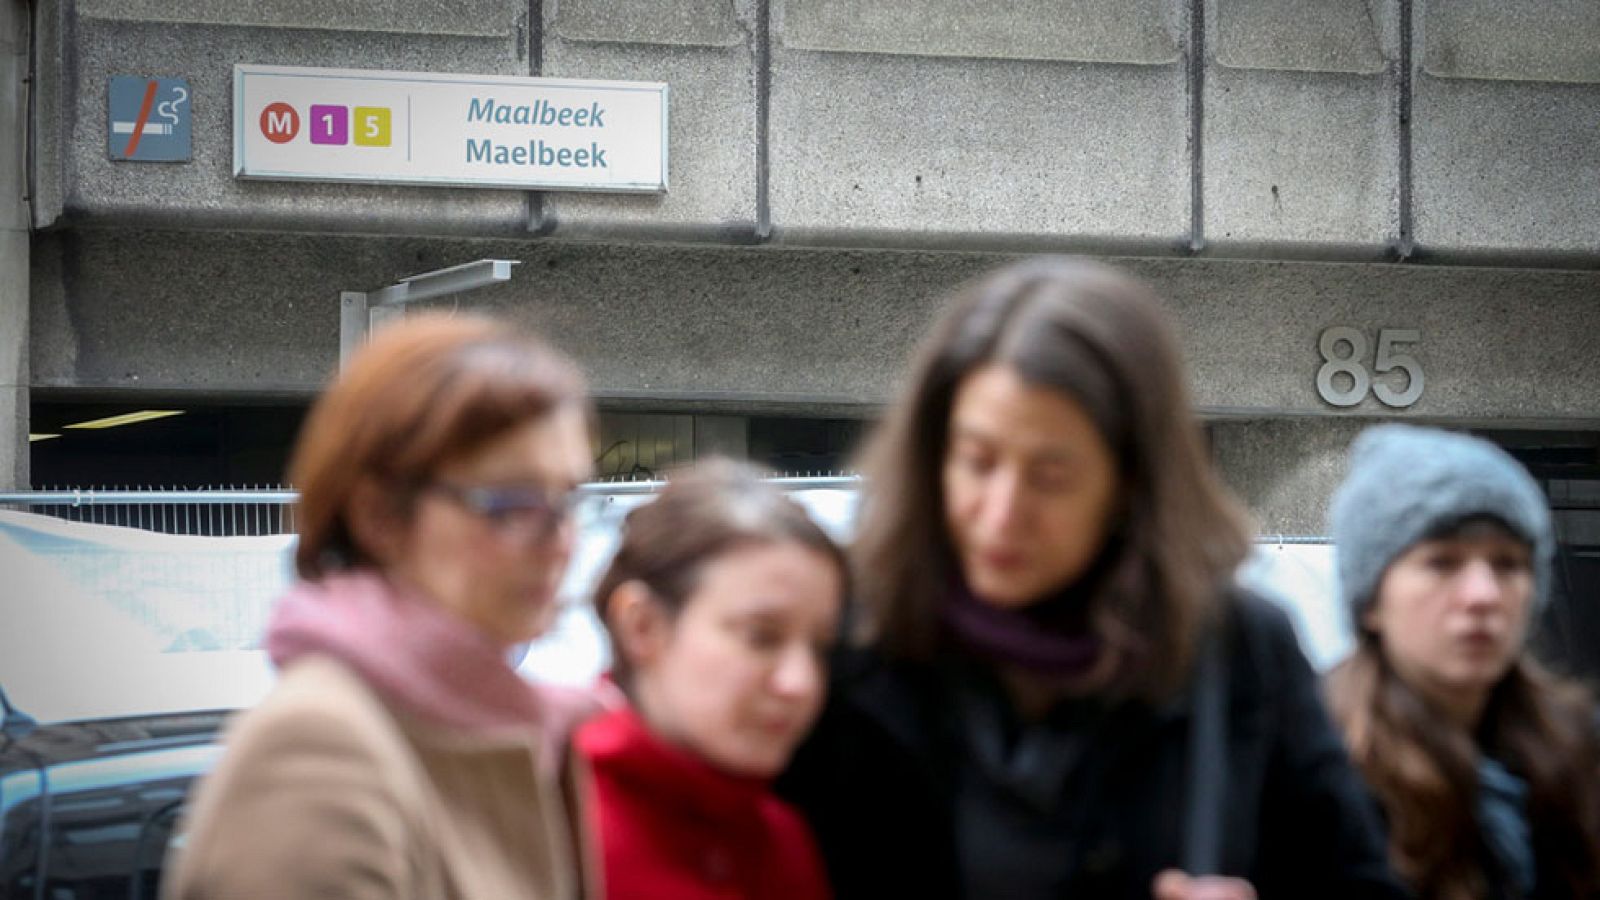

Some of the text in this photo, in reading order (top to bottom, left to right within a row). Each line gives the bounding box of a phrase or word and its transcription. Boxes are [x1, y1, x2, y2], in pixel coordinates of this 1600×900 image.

[267, 110, 380, 138] M 1 5
[467, 97, 605, 127] Maalbeek
[466, 138, 607, 168] Maelbeek
[1317, 326, 1425, 407] 85
